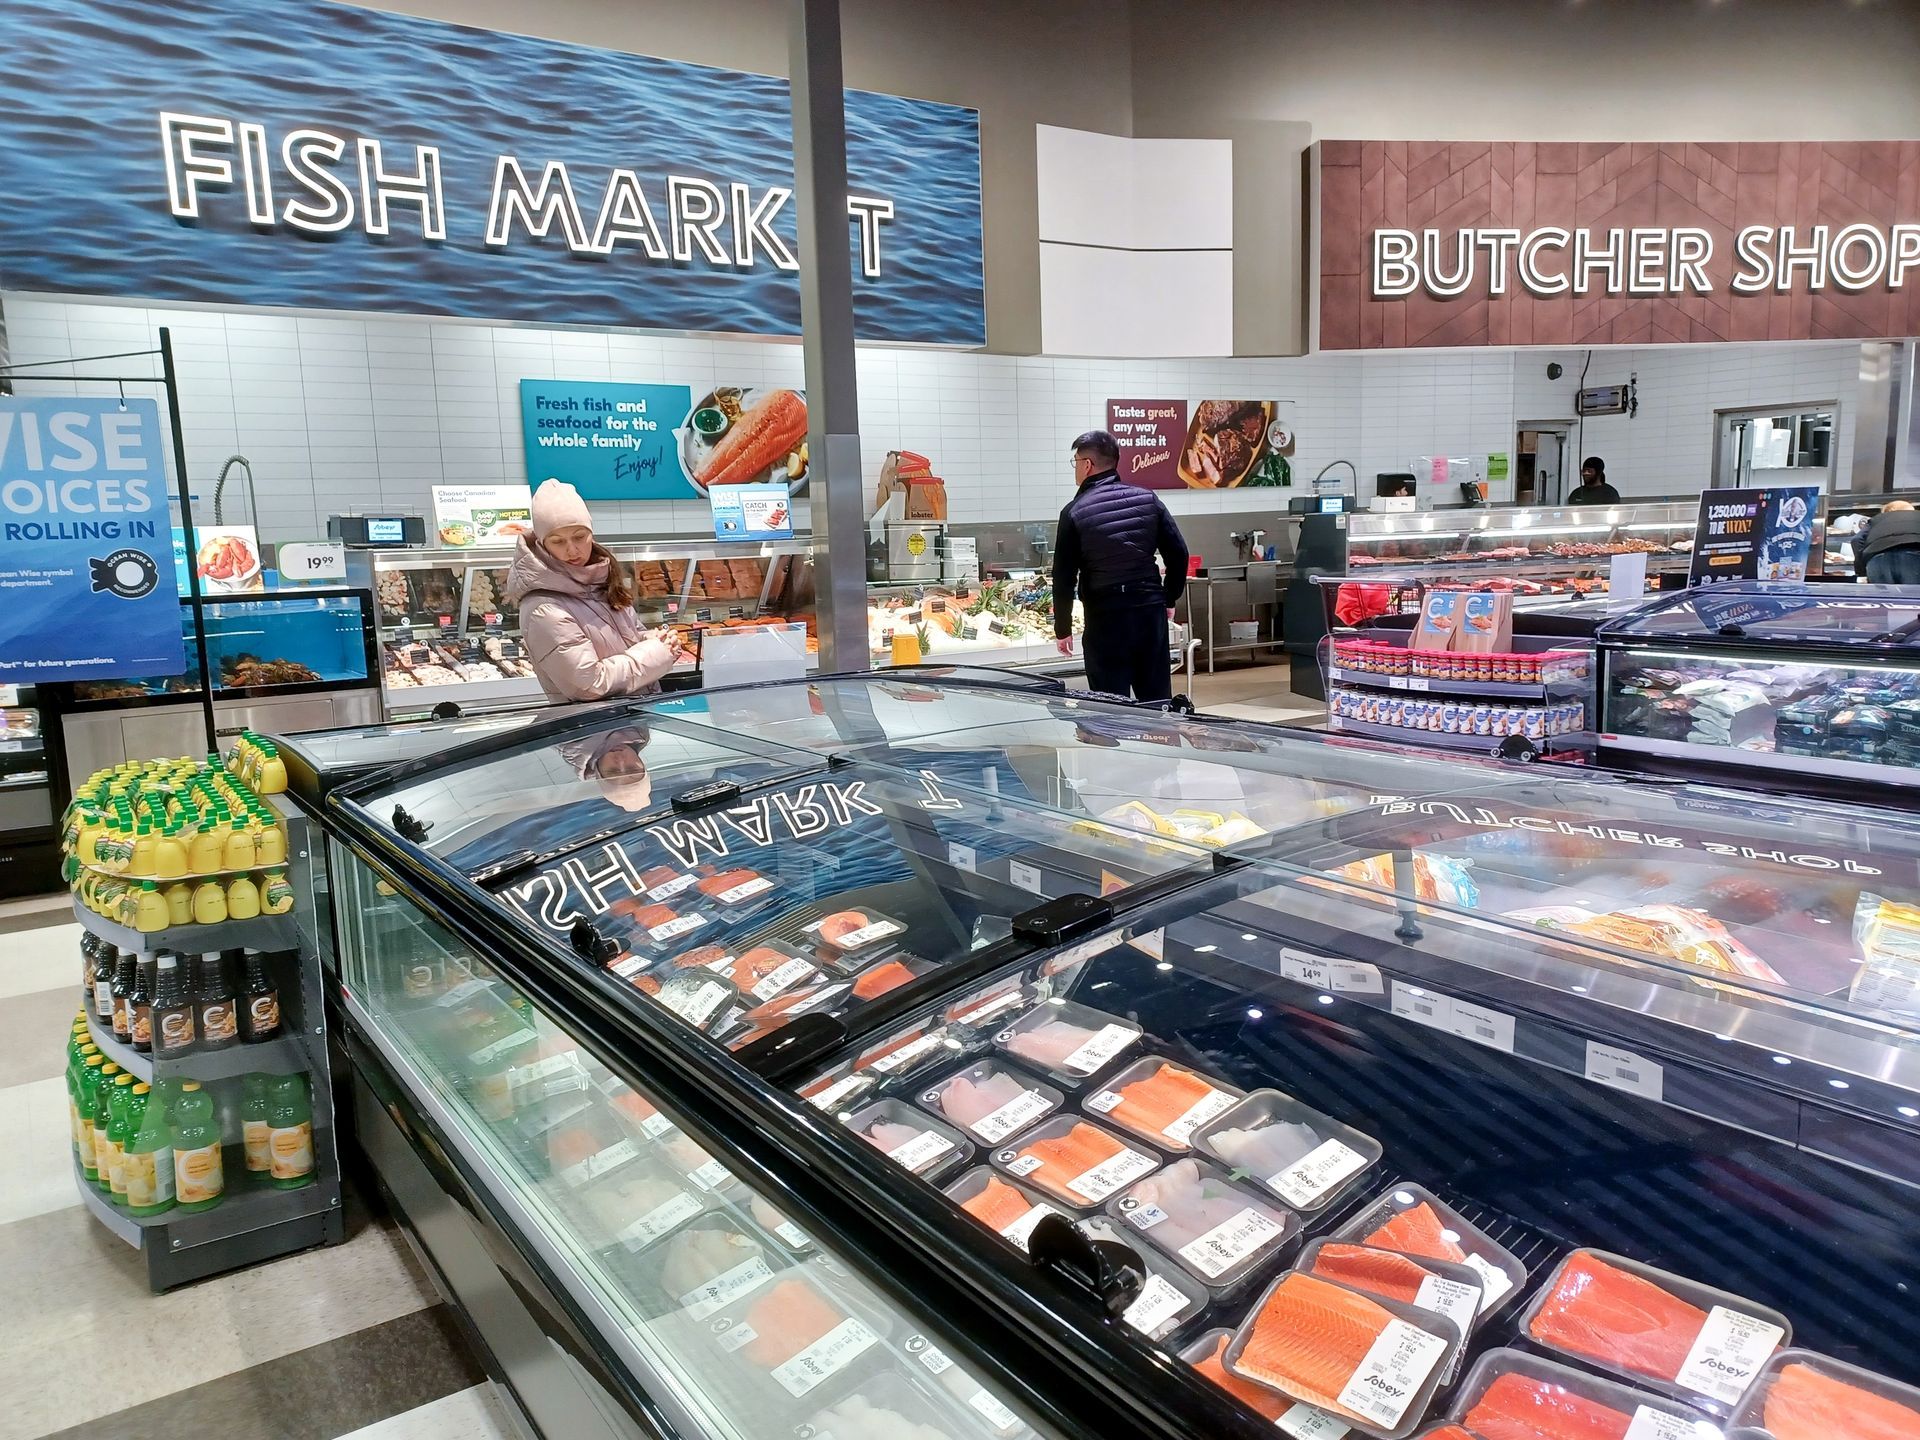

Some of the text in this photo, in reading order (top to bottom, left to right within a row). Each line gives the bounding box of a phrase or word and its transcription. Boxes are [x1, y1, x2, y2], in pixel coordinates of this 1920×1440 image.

[159, 112, 894, 277] FISH MARKT
[1373, 223, 1920, 296] BUTCHER SHOP
[535, 396, 646, 413] Fresh fish and
[1113, 405, 1177, 420] Tastes great,
[537, 415, 657, 431] seafood for the
[1113, 422, 1157, 435] any way
[538, 433, 642, 451] whole family
[1135, 436, 1157, 447] slice
[1158, 436, 1167, 446] it
[614, 446, 663, 480] Enjoy!
[1131, 449, 1171, 473] Delicious
[2, 480, 152, 514] OICES
[1708, 504, 1746, 520] 1,250,000
[5, 521, 155, 541] ROLLING IN
[1709, 521, 1717, 535] TO
[1717, 521, 1726, 534] BE
[107, 552, 147, 568] OCEAN WISE
[19, 569, 41, 577] Wise
[42, 568, 74, 577] symbol
[1, 579, 54, 588] department.
[65, 657, 116, 667] generations.
[1292, 1170, 1320, 1189] Sobeys
[1205, 1240, 1234, 1258] Sobeys
[800, 1357, 824, 1376] Sobeys
[1699, 1357, 1749, 1377] Sobeys
[1363, 1375, 1405, 1397] Sobeys
